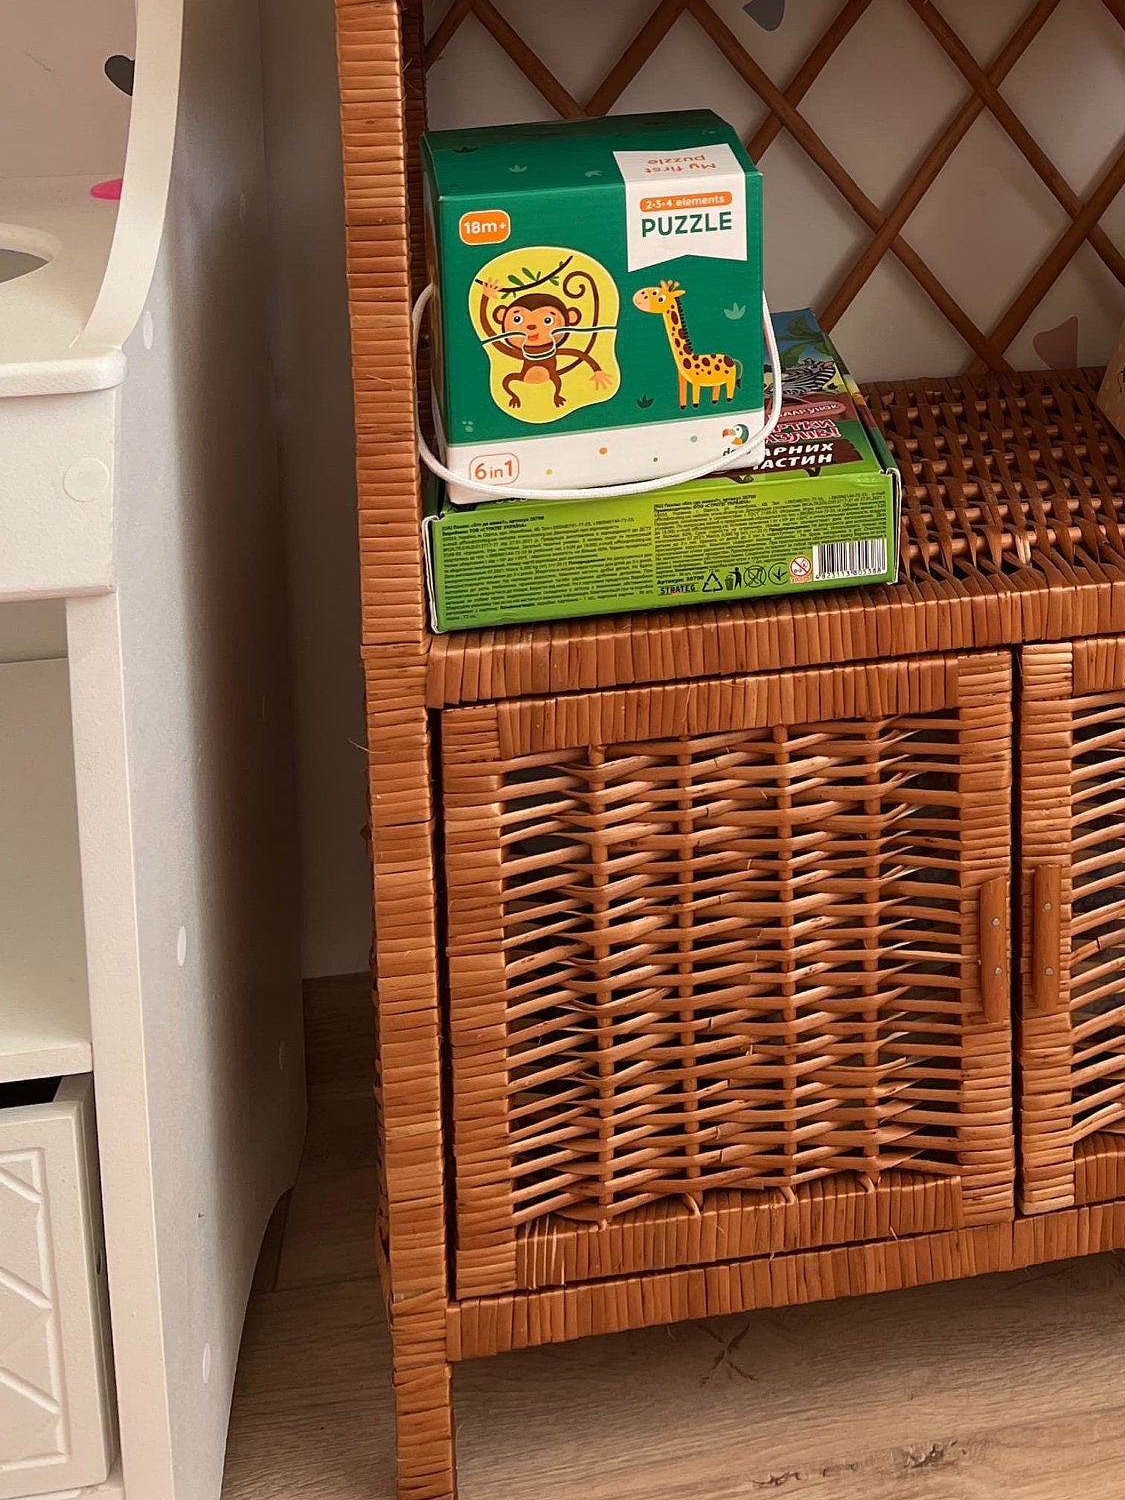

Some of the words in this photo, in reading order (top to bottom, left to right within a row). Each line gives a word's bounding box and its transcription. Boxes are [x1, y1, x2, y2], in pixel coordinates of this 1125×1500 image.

[648, 154, 706, 165] puzzle
[689, 163, 716, 172] My
[676, 194, 725, 207] elements
[464, 221, 507, 234] 18m+
[641, 211, 732, 238] PUZZLE
[753, 453, 833, 470] АСТИН
